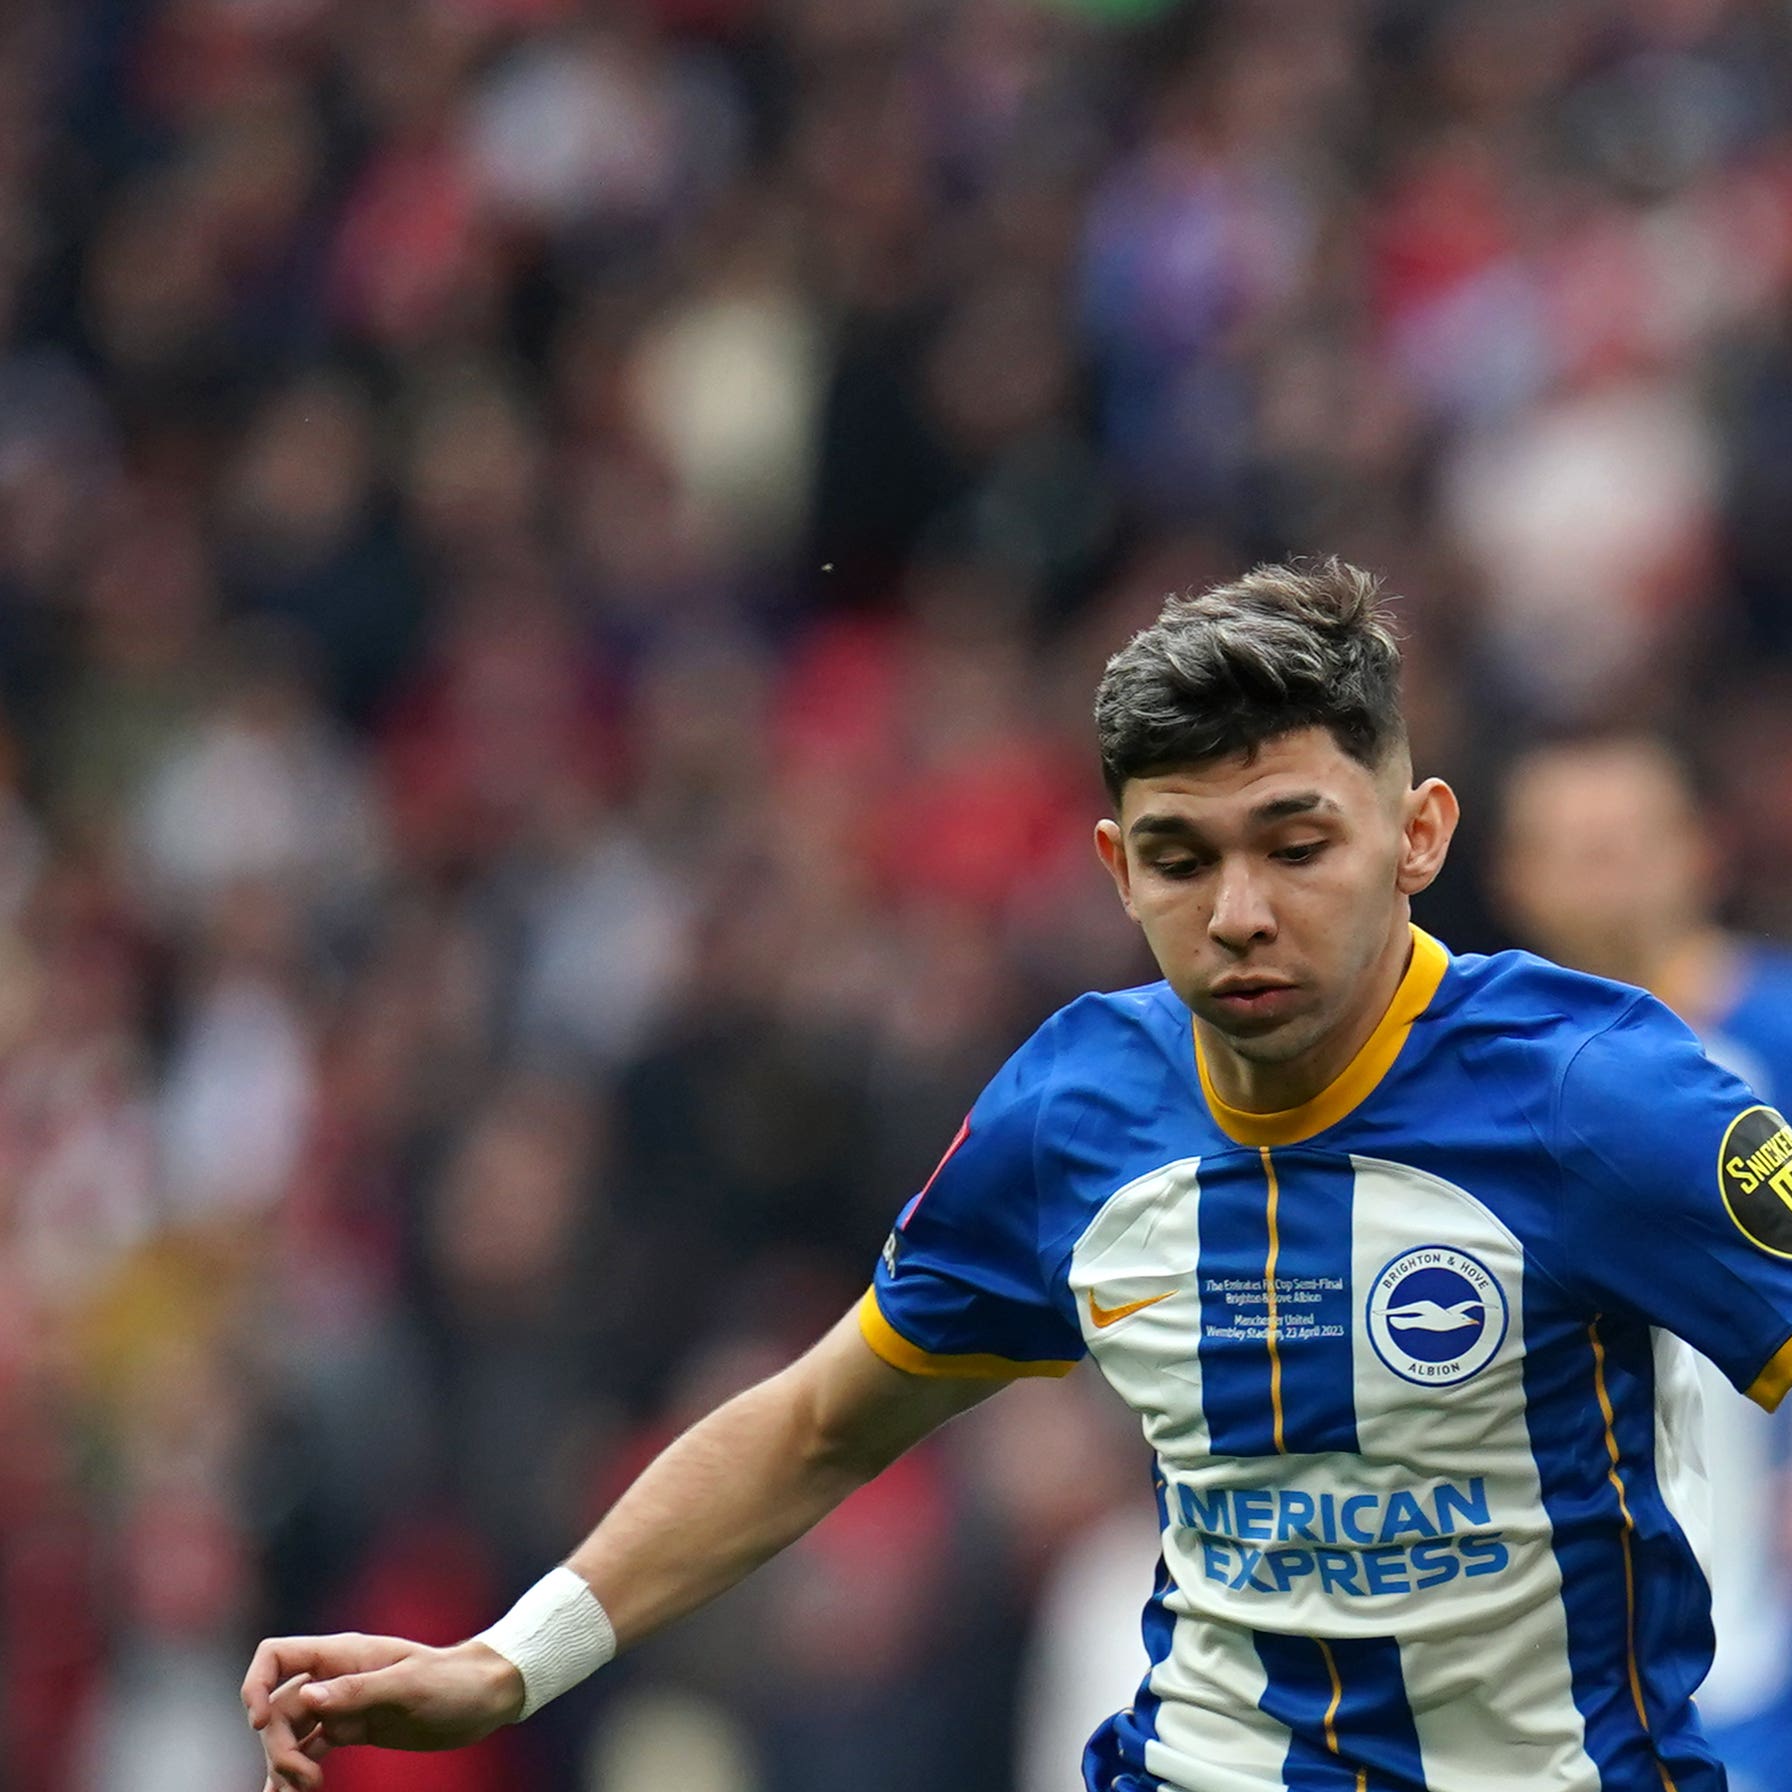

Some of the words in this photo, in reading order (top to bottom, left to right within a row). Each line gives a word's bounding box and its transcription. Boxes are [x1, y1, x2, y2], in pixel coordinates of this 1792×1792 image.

[1382, 1253, 1441, 1289] BRIGHTON
[1447, 1256, 1456, 1267] &
[1460, 1261, 1489, 1290] HOVE
[1206, 1280, 1223, 1291] The
[1275, 1279, 1293, 1292] Cup
[1226, 1293, 1262, 1306] Brighton
[1234, 1315, 1283, 1326] Mancheer
[1285, 1313, 1314, 1325] United
[1206, 1326, 1246, 1341] Wembley
[1246, 1327, 1284, 1341] Stadm,
[1286, 1328, 1297, 1338] 23
[1299, 1326, 1320, 1340] April
[1321, 1326, 1344, 1337] 2023
[1408, 1362, 1460, 1376] ALBION
[1177, 1477, 1492, 1545] MERICAN
[1200, 1531, 1509, 1597] EXPRESS
